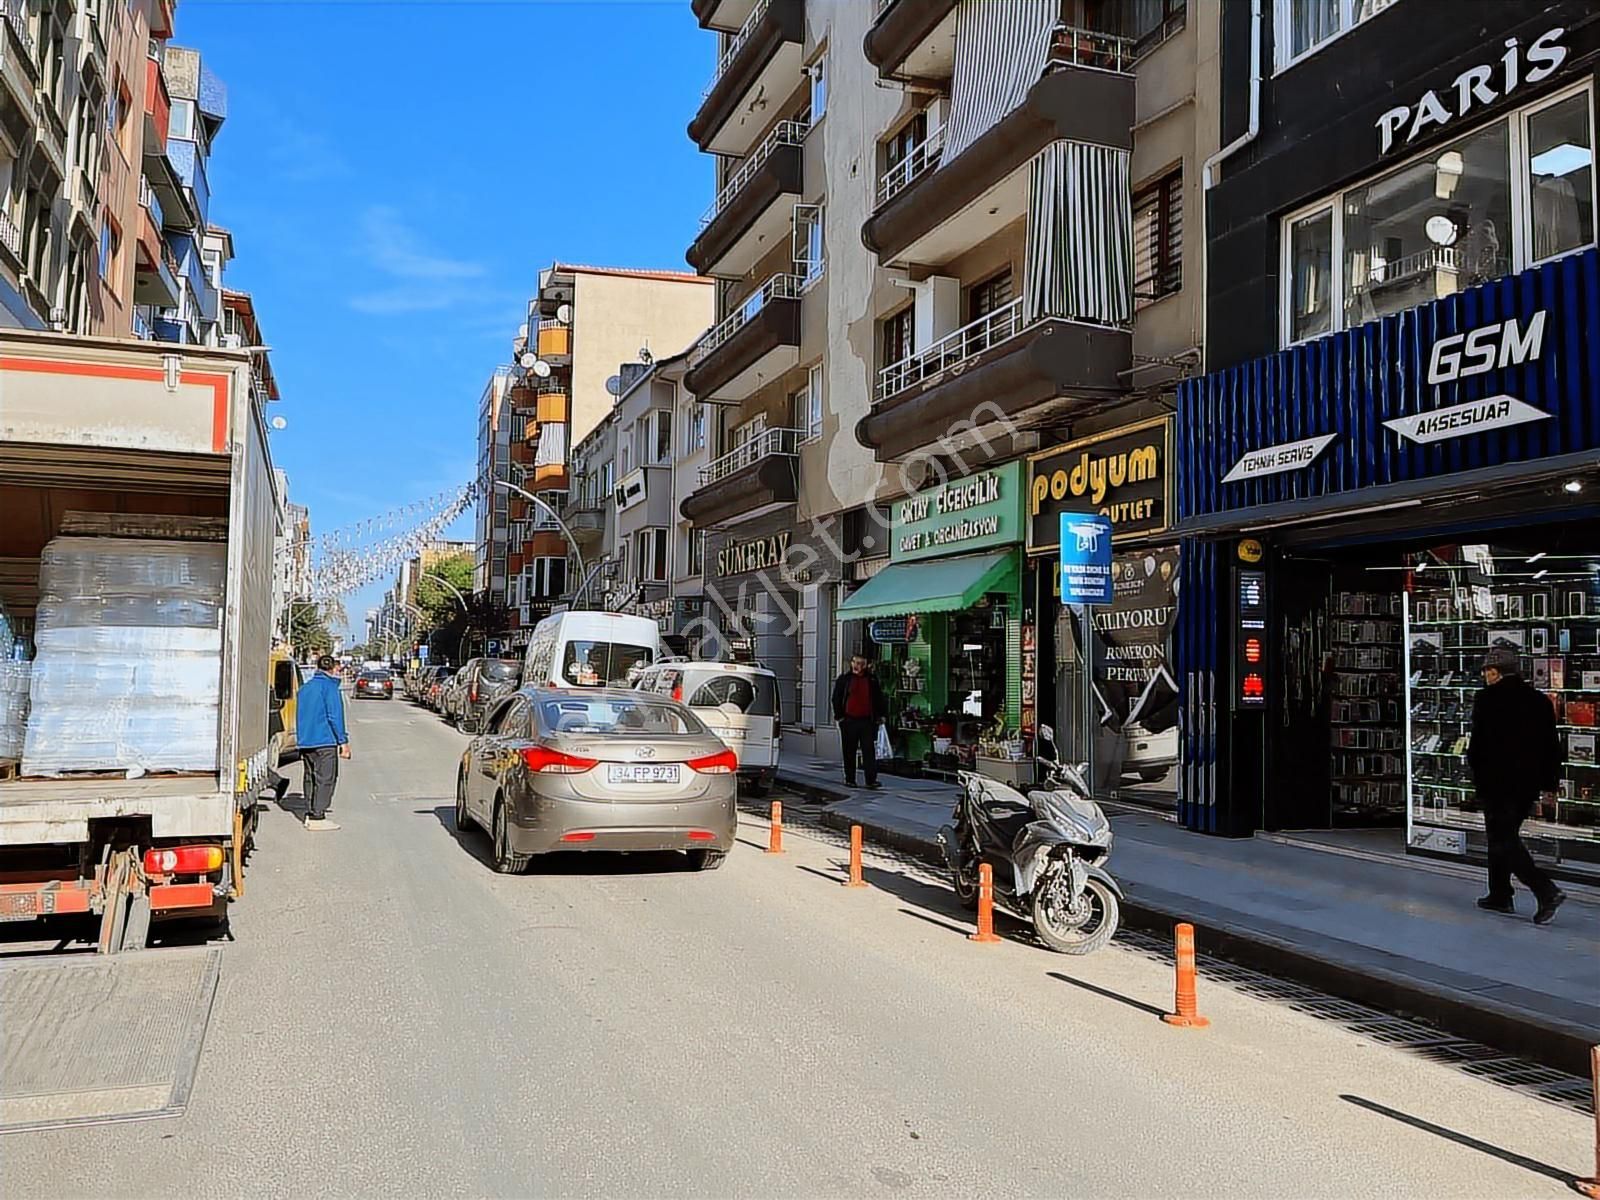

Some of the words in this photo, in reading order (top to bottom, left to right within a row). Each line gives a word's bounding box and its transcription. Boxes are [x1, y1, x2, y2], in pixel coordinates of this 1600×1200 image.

[1375, 27, 1568, 155] PARİS
[1428, 310, 1547, 385] GSM
[1415, 401, 1511, 436] AKSESUAR
[936, 472, 1000, 514] ÇİÇEKÇİLİK
[1032, 445, 1157, 516] podyum
[616, 767, 630, 778] 34
[653, 767, 677, 778] 9731
